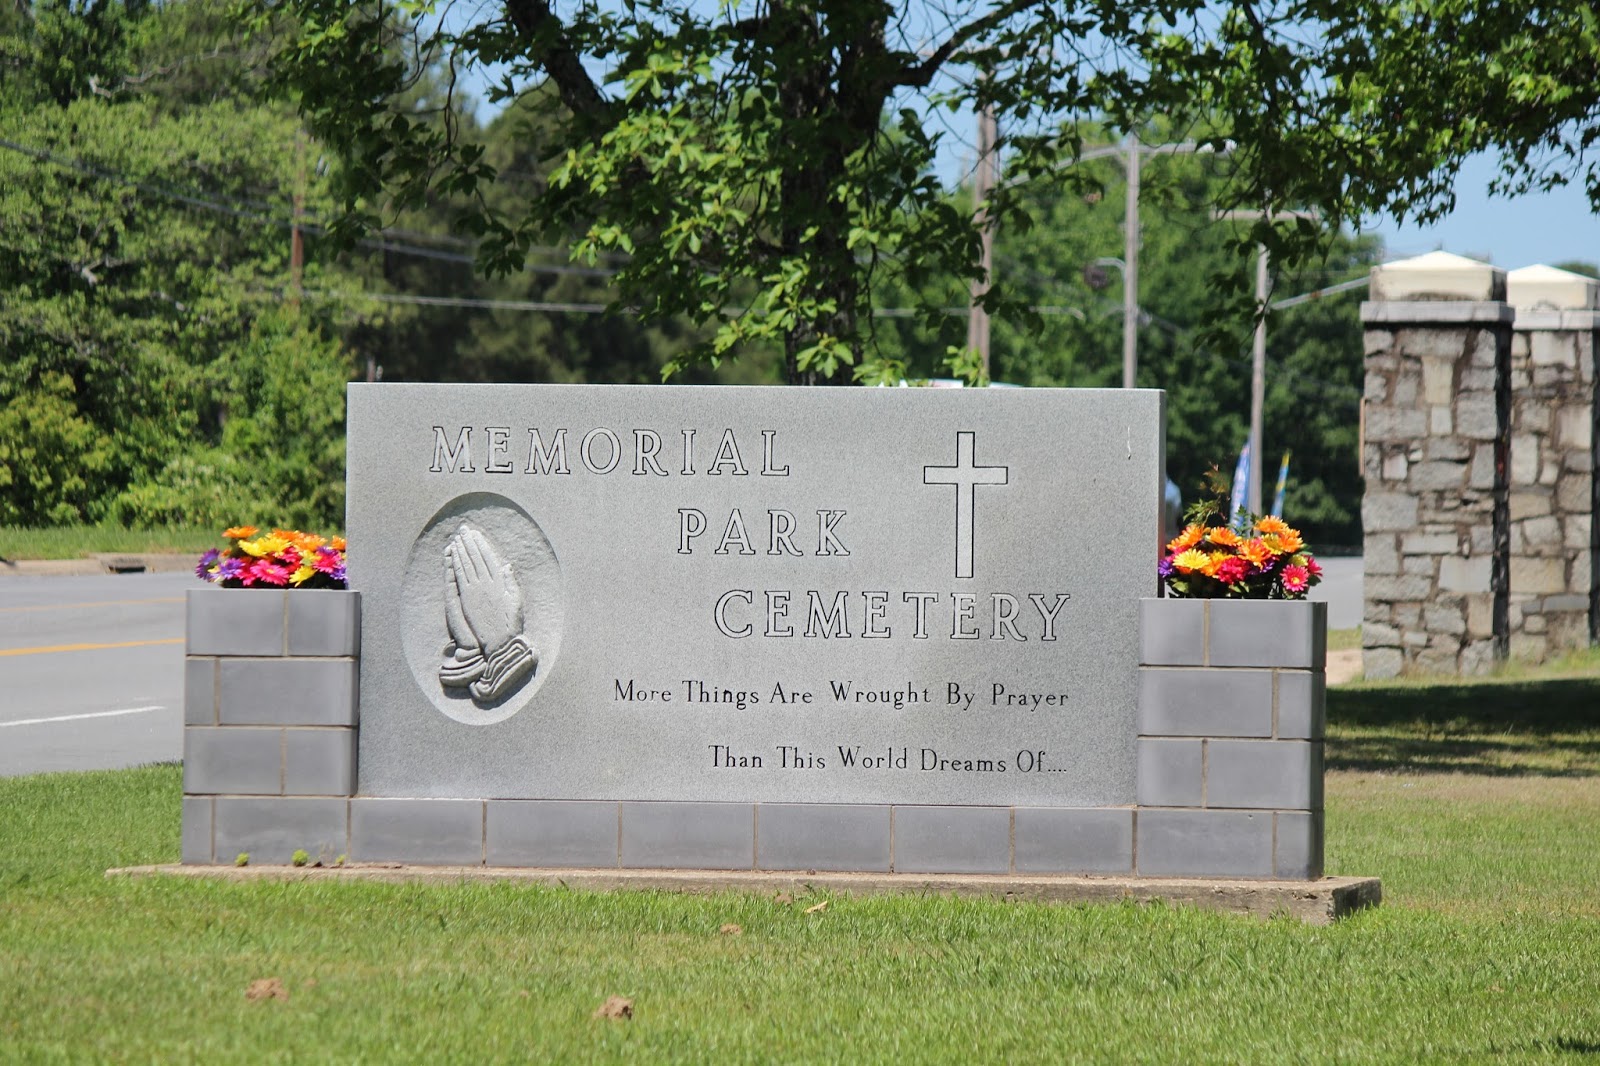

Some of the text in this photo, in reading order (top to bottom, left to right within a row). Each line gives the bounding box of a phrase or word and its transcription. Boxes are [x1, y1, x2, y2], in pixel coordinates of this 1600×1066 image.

[429, 425, 790, 477] MEMORIAL
[677, 507, 850, 557] PARK
[714, 588, 1071, 643] CEMETERY
[613, 679, 1070, 712] More Things Are Wrought By Prayer
[708, 745, 763, 770] Than
[776, 746, 826, 770] This
[838, 746, 908, 771] World
[920, 748, 1007, 773] Dreams
